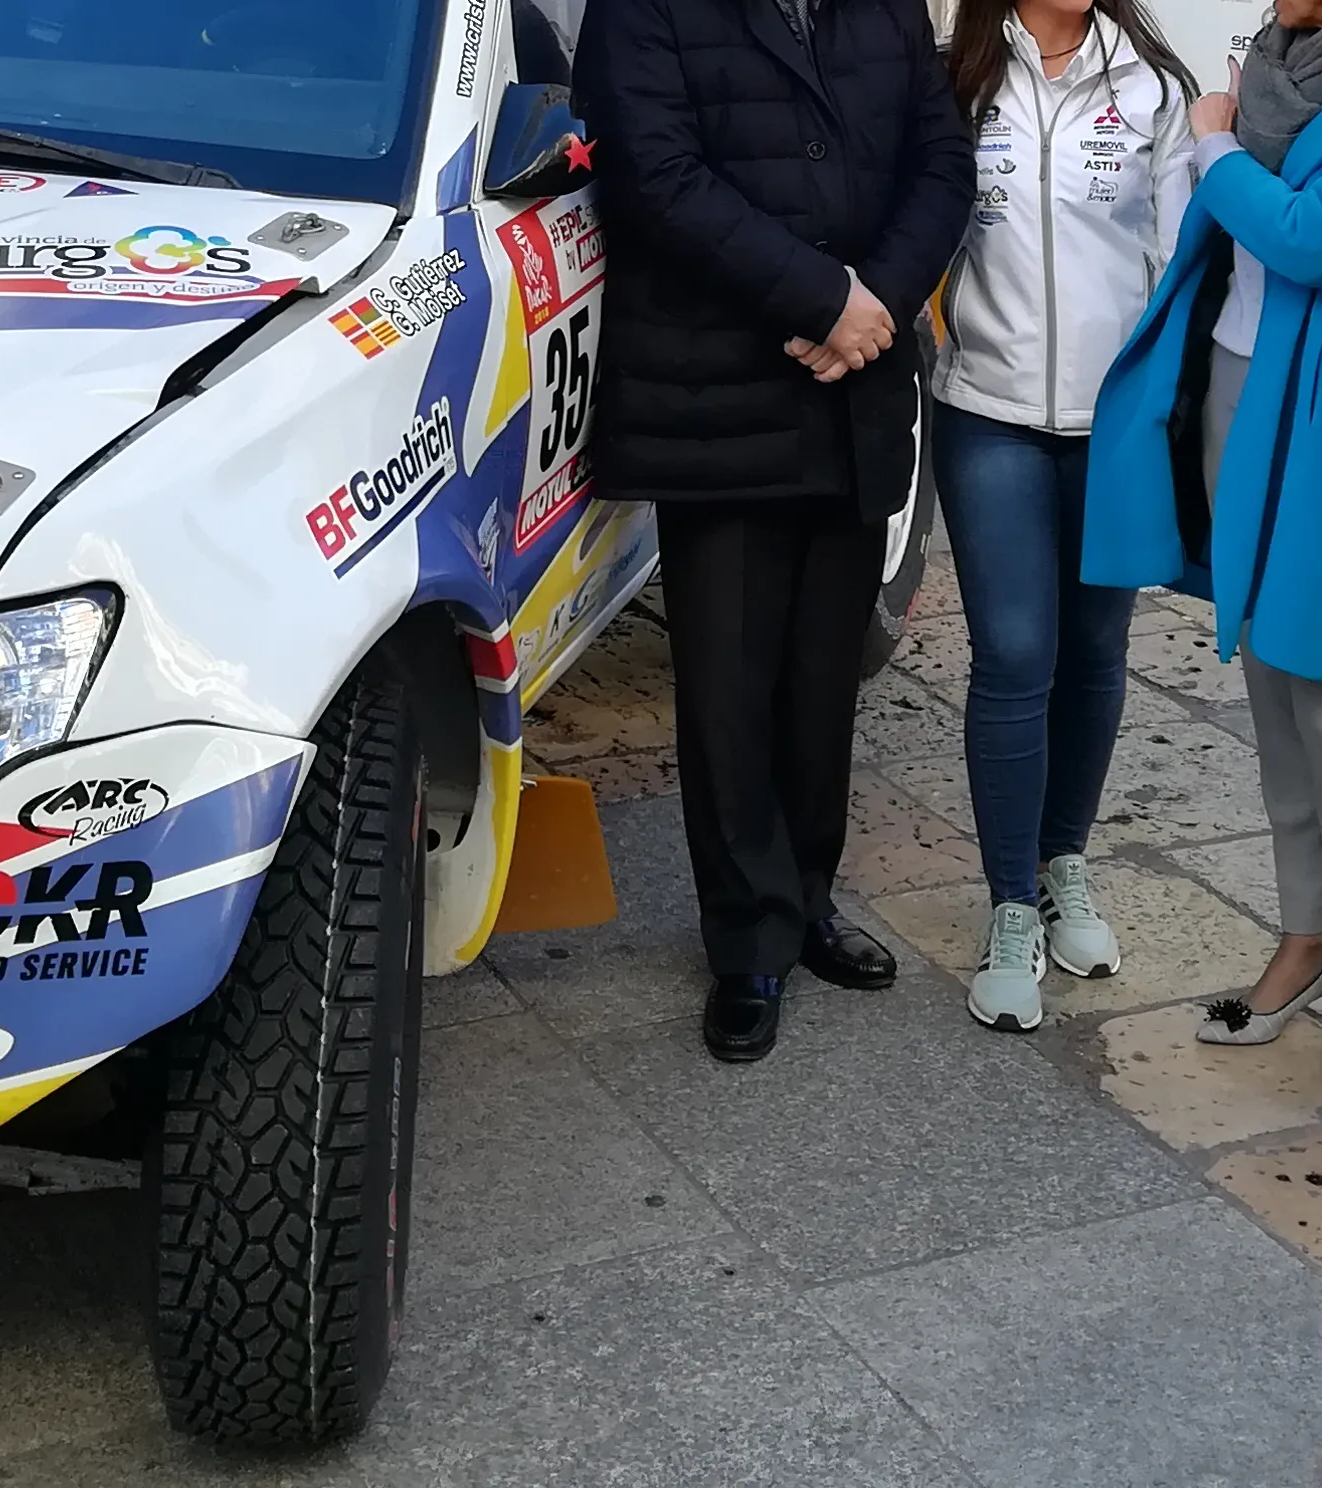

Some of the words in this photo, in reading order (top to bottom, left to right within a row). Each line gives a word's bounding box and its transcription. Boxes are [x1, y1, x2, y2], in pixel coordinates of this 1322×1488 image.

[1080, 140, 1127, 150] UREMOVIL
[1084, 160, 1113, 172] ASTI
[83, 236, 107, 246] de
[71, 280, 149, 294] origen
[153, 283, 167, 295] y
[370, 287, 402, 314] C.
[389, 247, 467, 302] Gutiérrez
[391, 310, 421, 337] G.
[408, 280, 468, 327] Moiset
[540, 309, 600, 472] 35
[306, 402, 453, 560] BFGoodrich
[521, 462, 573, 535] MOTUL
[47, 777, 153, 814] ARC
[68, 802, 149, 846] Racing
[19, 948, 148, 981] SERVICE
